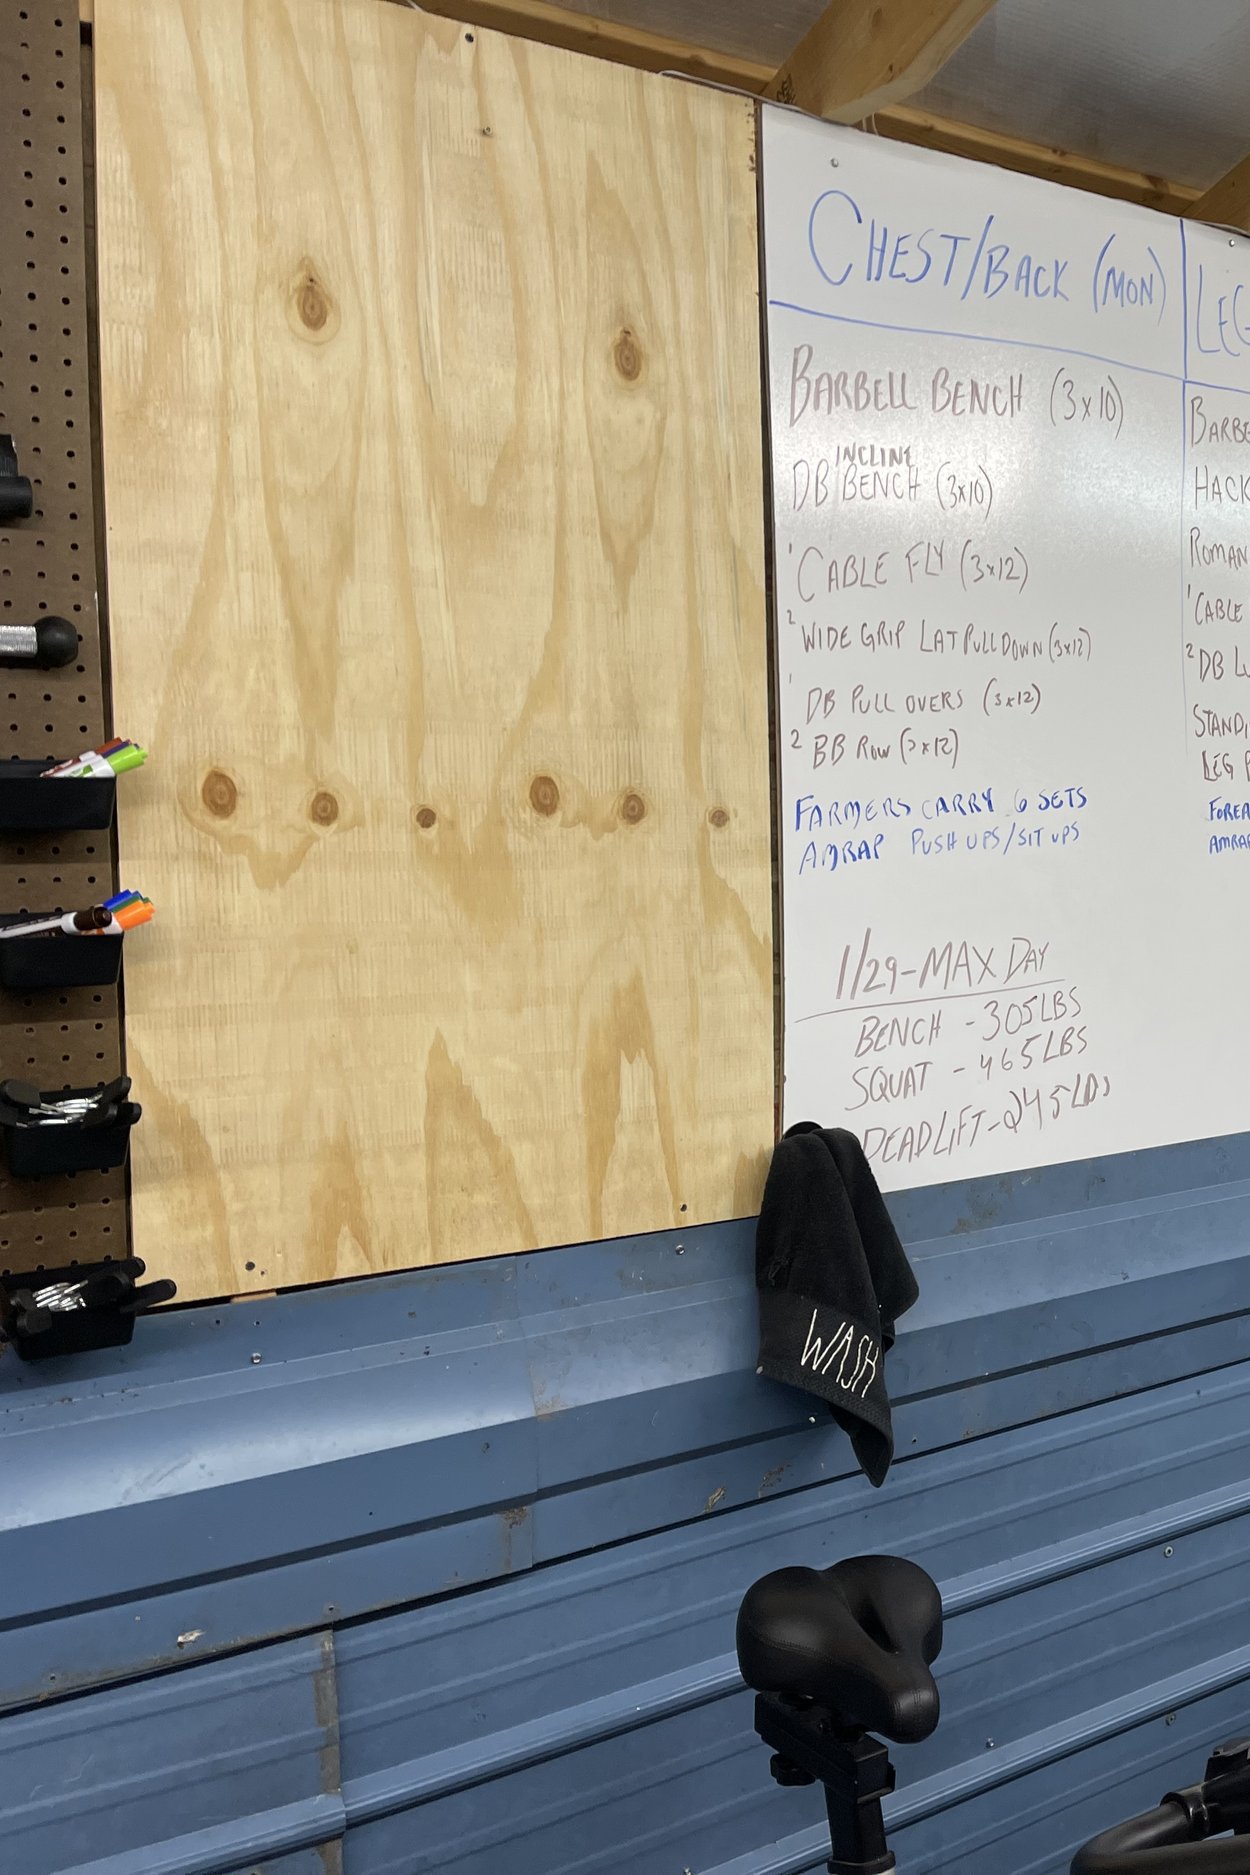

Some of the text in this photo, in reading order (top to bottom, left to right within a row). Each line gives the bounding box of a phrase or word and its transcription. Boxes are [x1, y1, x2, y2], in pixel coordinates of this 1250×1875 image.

[809, 190, 1166, 326] CHEST/BACK (MON)
[789, 344, 916, 428] BARBELL
[932, 367, 1023, 418] BENCH
[836, 444, 914, 467] INCLINE
[793, 459, 829, 511] DB
[842, 463, 921, 500] BENCH
[797, 546, 890, 602] CABLE
[905, 540, 944, 583] FLY
[1194, 591, 1243, 626] CABLE
[802, 622, 852, 653] WIDE
[860, 619, 905, 652] GRIP
[1199, 647, 1224, 683] DB
[806, 687, 836, 725] DB
[812, 733, 846, 769] BB
[1202, 750, 1234, 782] LEG
[795, 794, 912, 832] FARMERS
[922, 787, 994, 821] CARRY
[1038, 786, 1088, 811] SETS
[911, 828, 958, 855] PUSH
[1003, 937, 1050, 985] DAY
[854, 1009, 942, 1058] BENCH
[845, 1061, 933, 1111] SQUAT
[800, 1308, 879, 1398] WASH
